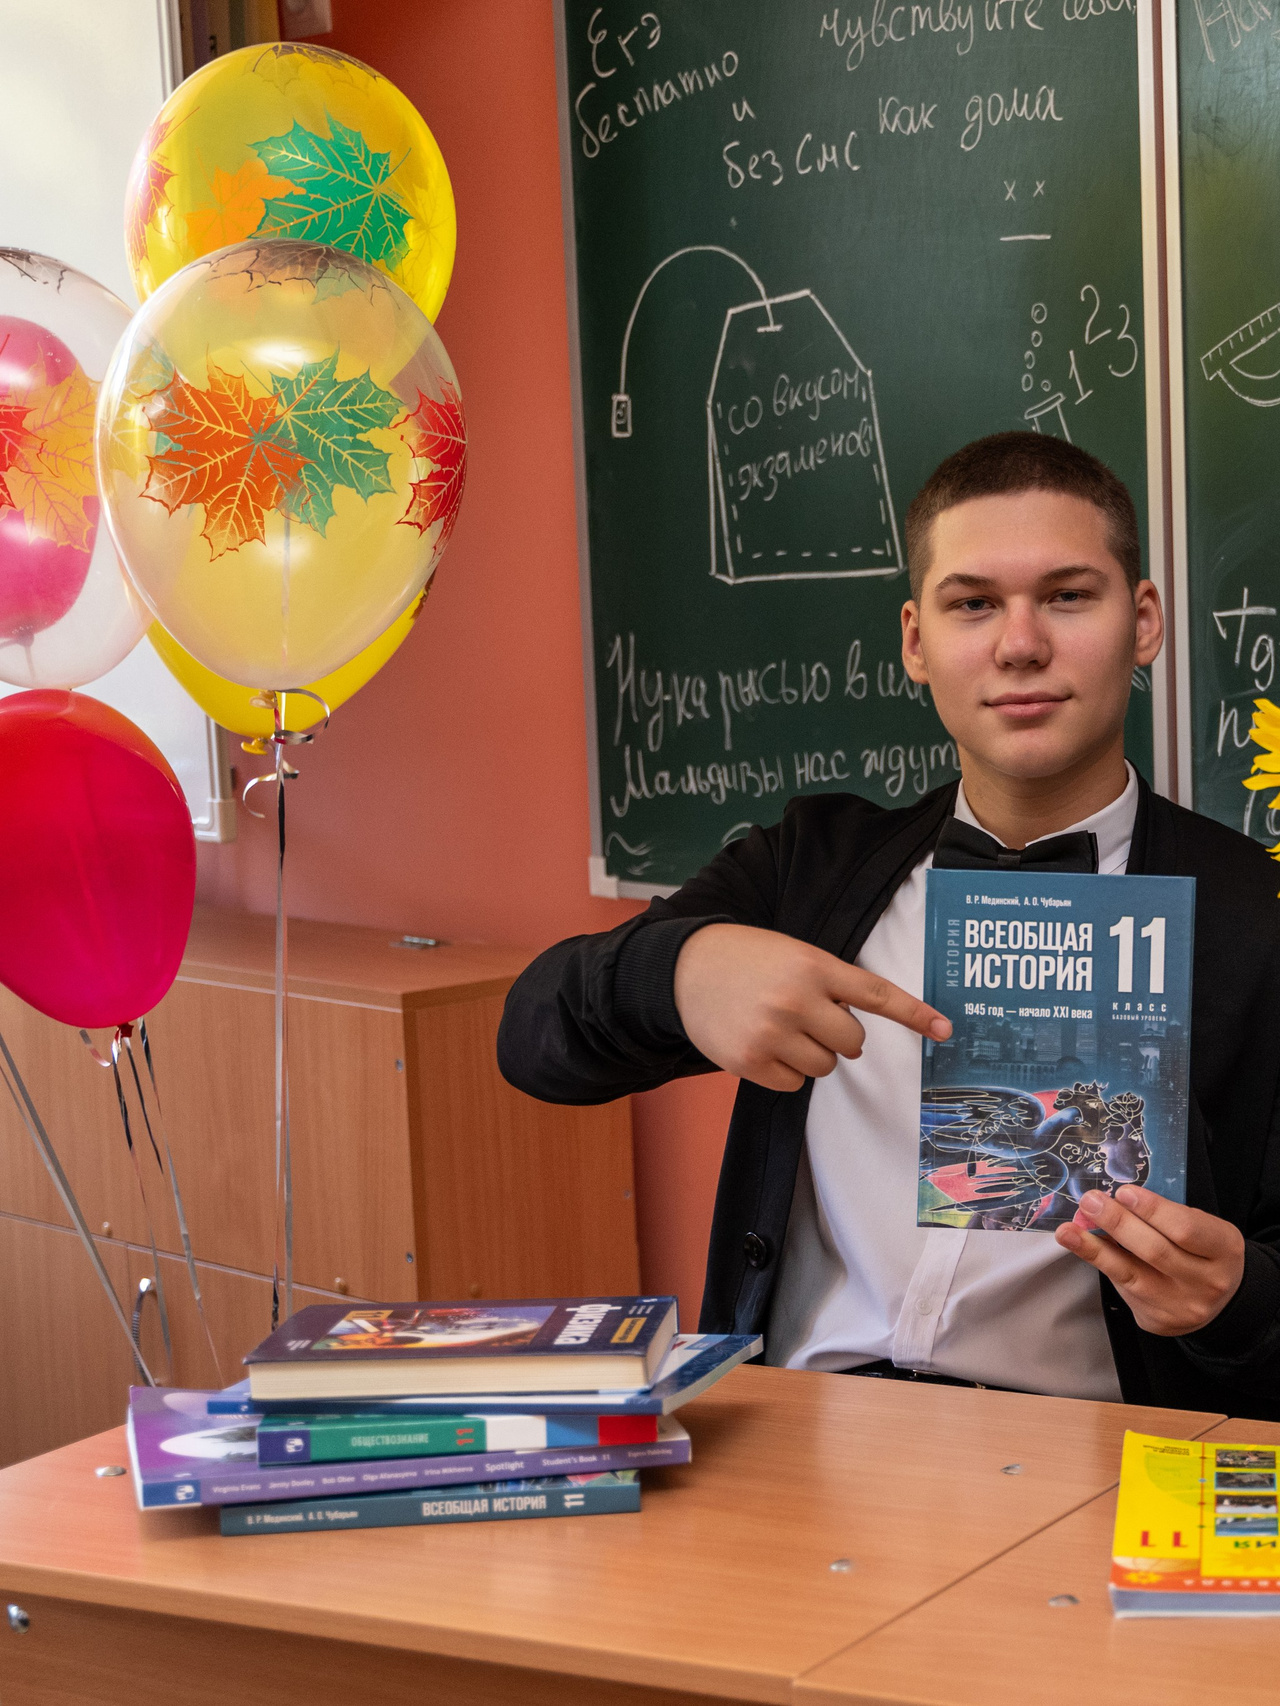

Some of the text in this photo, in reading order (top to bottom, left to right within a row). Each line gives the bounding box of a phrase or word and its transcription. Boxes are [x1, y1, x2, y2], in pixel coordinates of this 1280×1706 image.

[732, 96, 755, 121] и
[960, 85, 1063, 151] дома
[722, 140, 784, 189] без
[728, 367, 859, 434] со вкусом
[738, 417, 871, 501] экзаменов
[716, 659, 831, 750] рысью
[610, 740, 962, 817] Мальдивы нас ждут
[1040, 897, 1072, 908] Чубарьян
[946, 918, 961, 987] ИСТОРИЯ
[964, 919, 1093, 955] ВСЕОБЩАЯ
[1109, 916, 1166, 994] 11
[964, 953, 1093, 992] ИСТОРИЯ
[964, 1003, 986, 1016] 1945
[988, 1006, 1004, 1018] год
[1019, 1006, 1051, 1018] начало
[1071, 1008, 1093, 1019] века
[1112, 1002, 1167, 1012] класс
[351, 1433, 429, 1447] ОБЩЕСТВОЗНАНИЕ
[485, 1460, 525, 1472] Spotlight
[542, 1456, 578, 1466] Student's
[579, 1455, 597, 1463] Book
[422, 1495, 547, 1518] ВСЕОБЩАЯ ИСТОРИЯ
[563, 1494, 585, 1509] 11
[1140, 1530, 1189, 1548] 11
